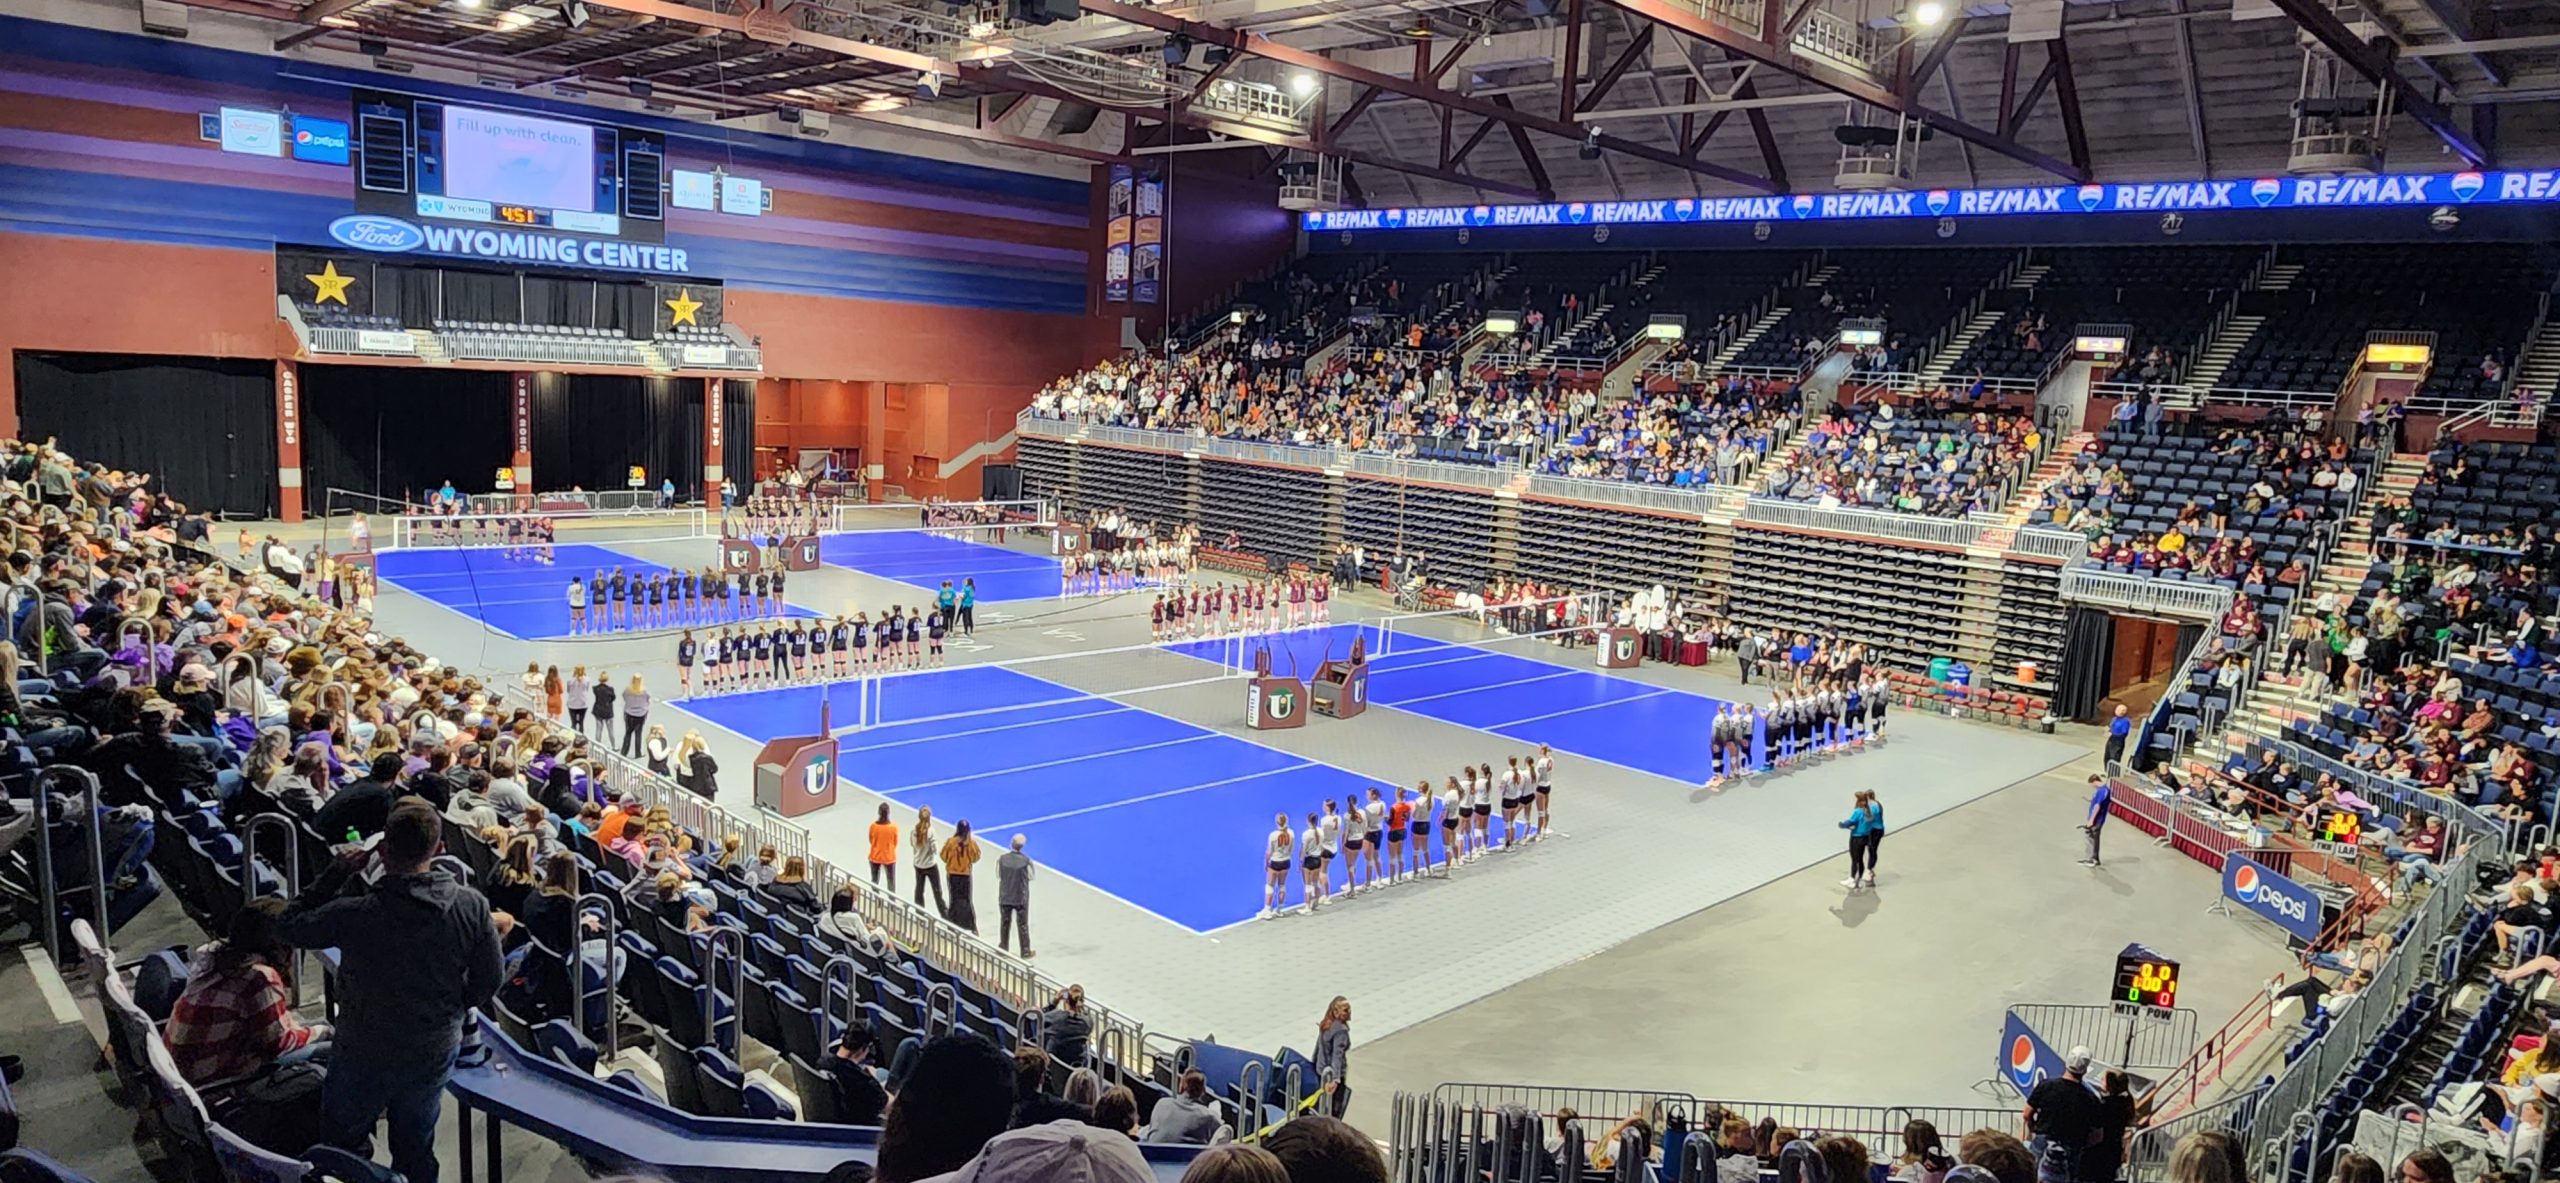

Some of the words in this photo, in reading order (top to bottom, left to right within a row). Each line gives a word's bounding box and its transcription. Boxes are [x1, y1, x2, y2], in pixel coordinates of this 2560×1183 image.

[313, 136, 345, 149] pepsi
[457, 117, 480, 132] Fill
[484, 124, 502, 138] up
[505, 126, 537, 142] with
[540, 128, 582, 147] clean.
[2115, 182, 2237, 210] RE/MAX
[2294, 174, 2433, 205] RE/MAX
[447, 203, 491, 217] WYOMING
[1701, 196, 1785, 221] RE/MAX
[1821, 193, 1916, 218] RE/MAX
[1959, 188, 2065, 214] RE/MAX
[1326, 213, 1380, 229] RE/MAX
[1406, 209, 1469, 227] RE/MAX
[1494, 205, 1563, 225] RE/MAX
[1592, 201, 1669, 223] RE/MAX
[349, 221, 405, 246] Ford
[422, 224, 580, 262] WYOMING
[583, 240, 689, 273] CENTER
[803, 545, 817, 563] U
[1615, 640, 1635, 661] U
[1353, 678, 1366, 704] U
[1267, 693, 1294, 719] U
[804, 759, 831, 796] U
[2325, 831, 2334, 841] 0
[2348, 833, 2357, 844] 0
[2337, 845, 2356, 855] LAR
[2258, 884, 2307, 922] pepsi
[2141, 963, 2153, 977] 0
[2159, 965, 2171, 980] 0
[2129, 987, 2140, 1001] 0
[2160, 992, 2171, 1006] 0
[2114, 1003, 2140, 1017] MTV
[2146, 1007, 2173, 1021] POW
